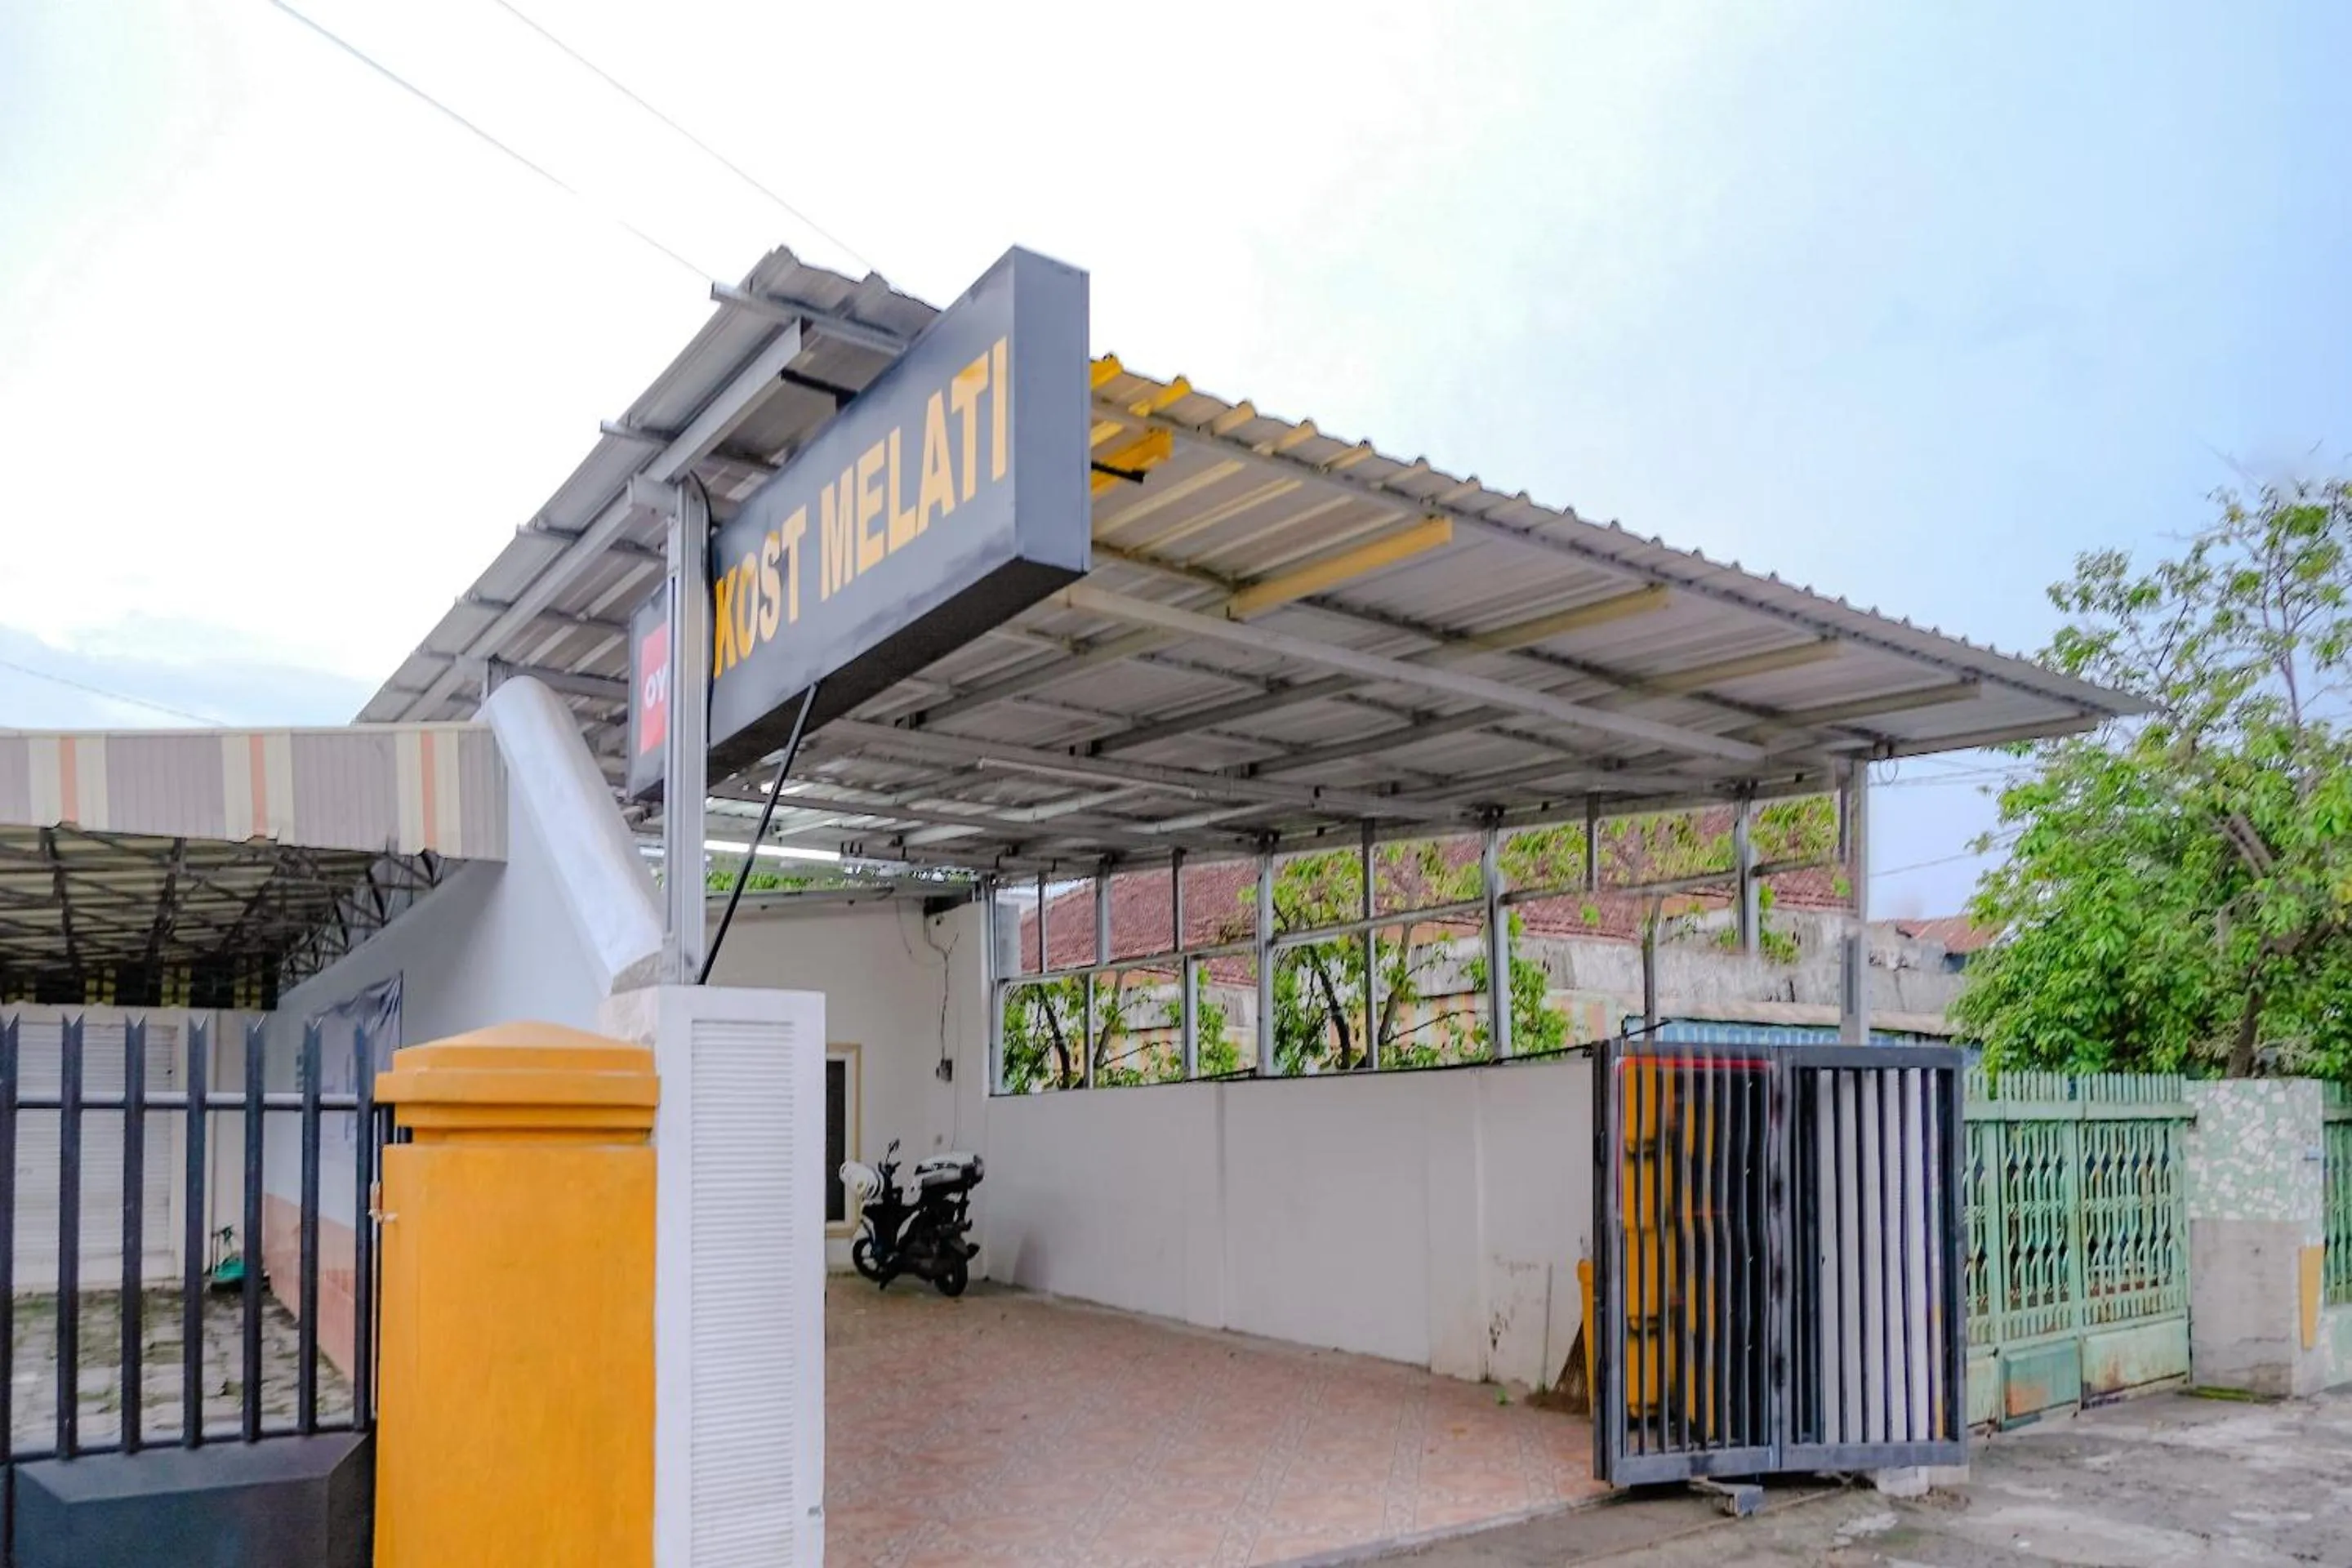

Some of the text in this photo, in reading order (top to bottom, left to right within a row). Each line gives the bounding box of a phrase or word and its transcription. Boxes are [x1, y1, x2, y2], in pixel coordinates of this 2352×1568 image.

[714, 336, 1008, 679] KOST MELATI
[644, 662, 668, 709] OY
